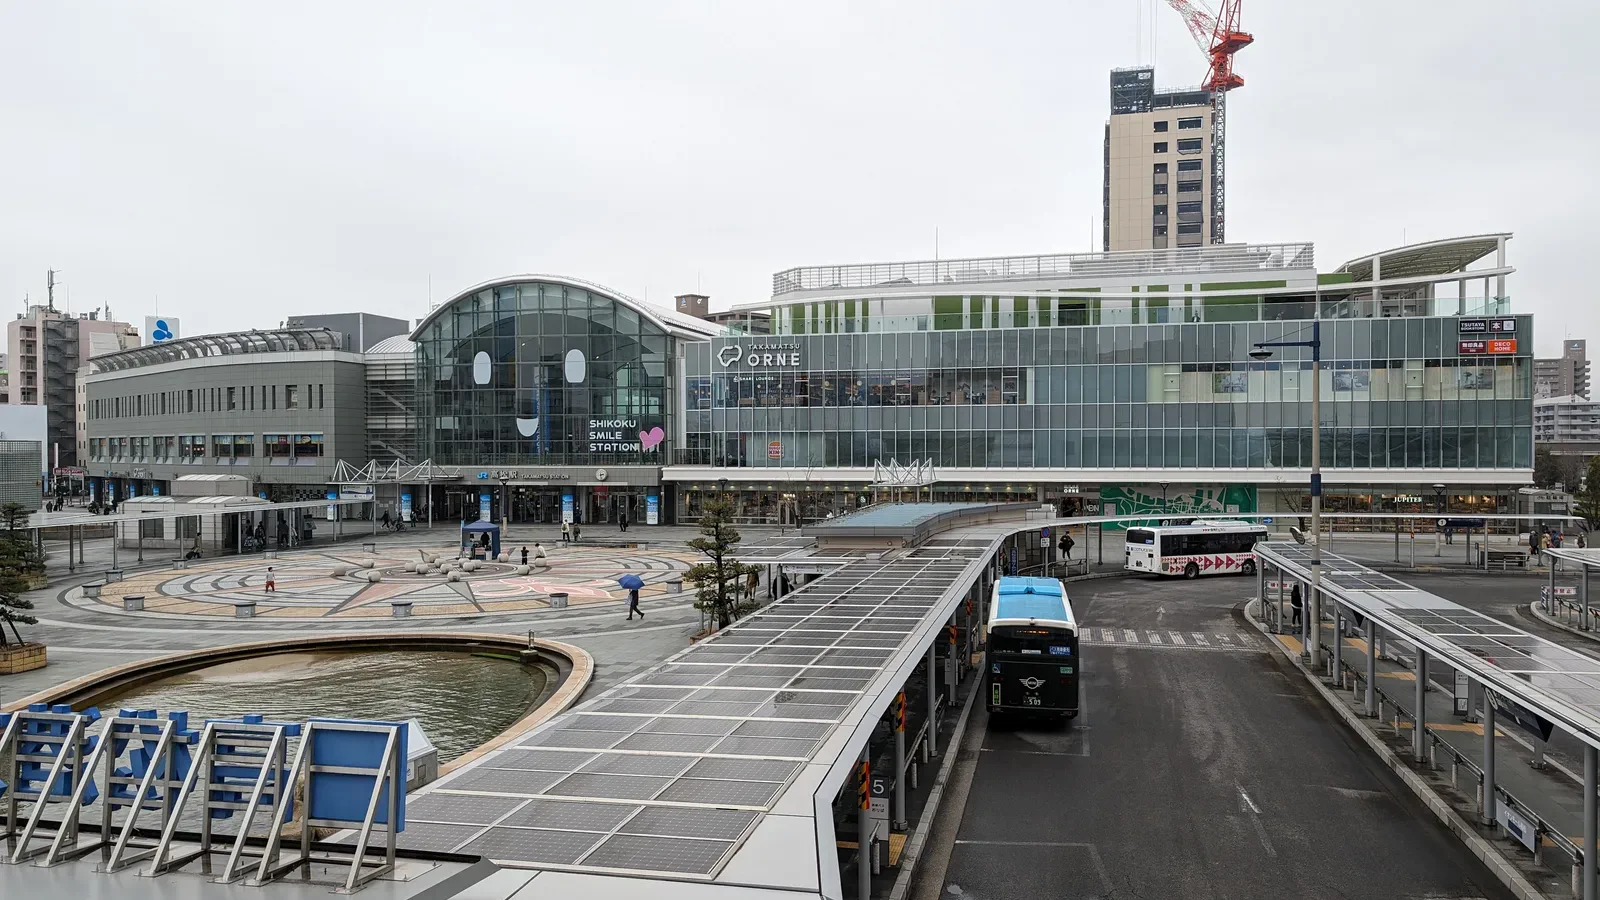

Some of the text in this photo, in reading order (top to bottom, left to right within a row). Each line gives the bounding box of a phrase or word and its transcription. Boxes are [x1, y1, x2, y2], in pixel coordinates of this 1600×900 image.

[747, 353, 800, 366] ORNE
[589, 419, 636, 428] SHIKOKU
[589, 431, 622, 440] SMILE
[589, 443, 637, 452] STATION
[476, 471, 489, 479] JR
[872, 779, 885, 794] 5
